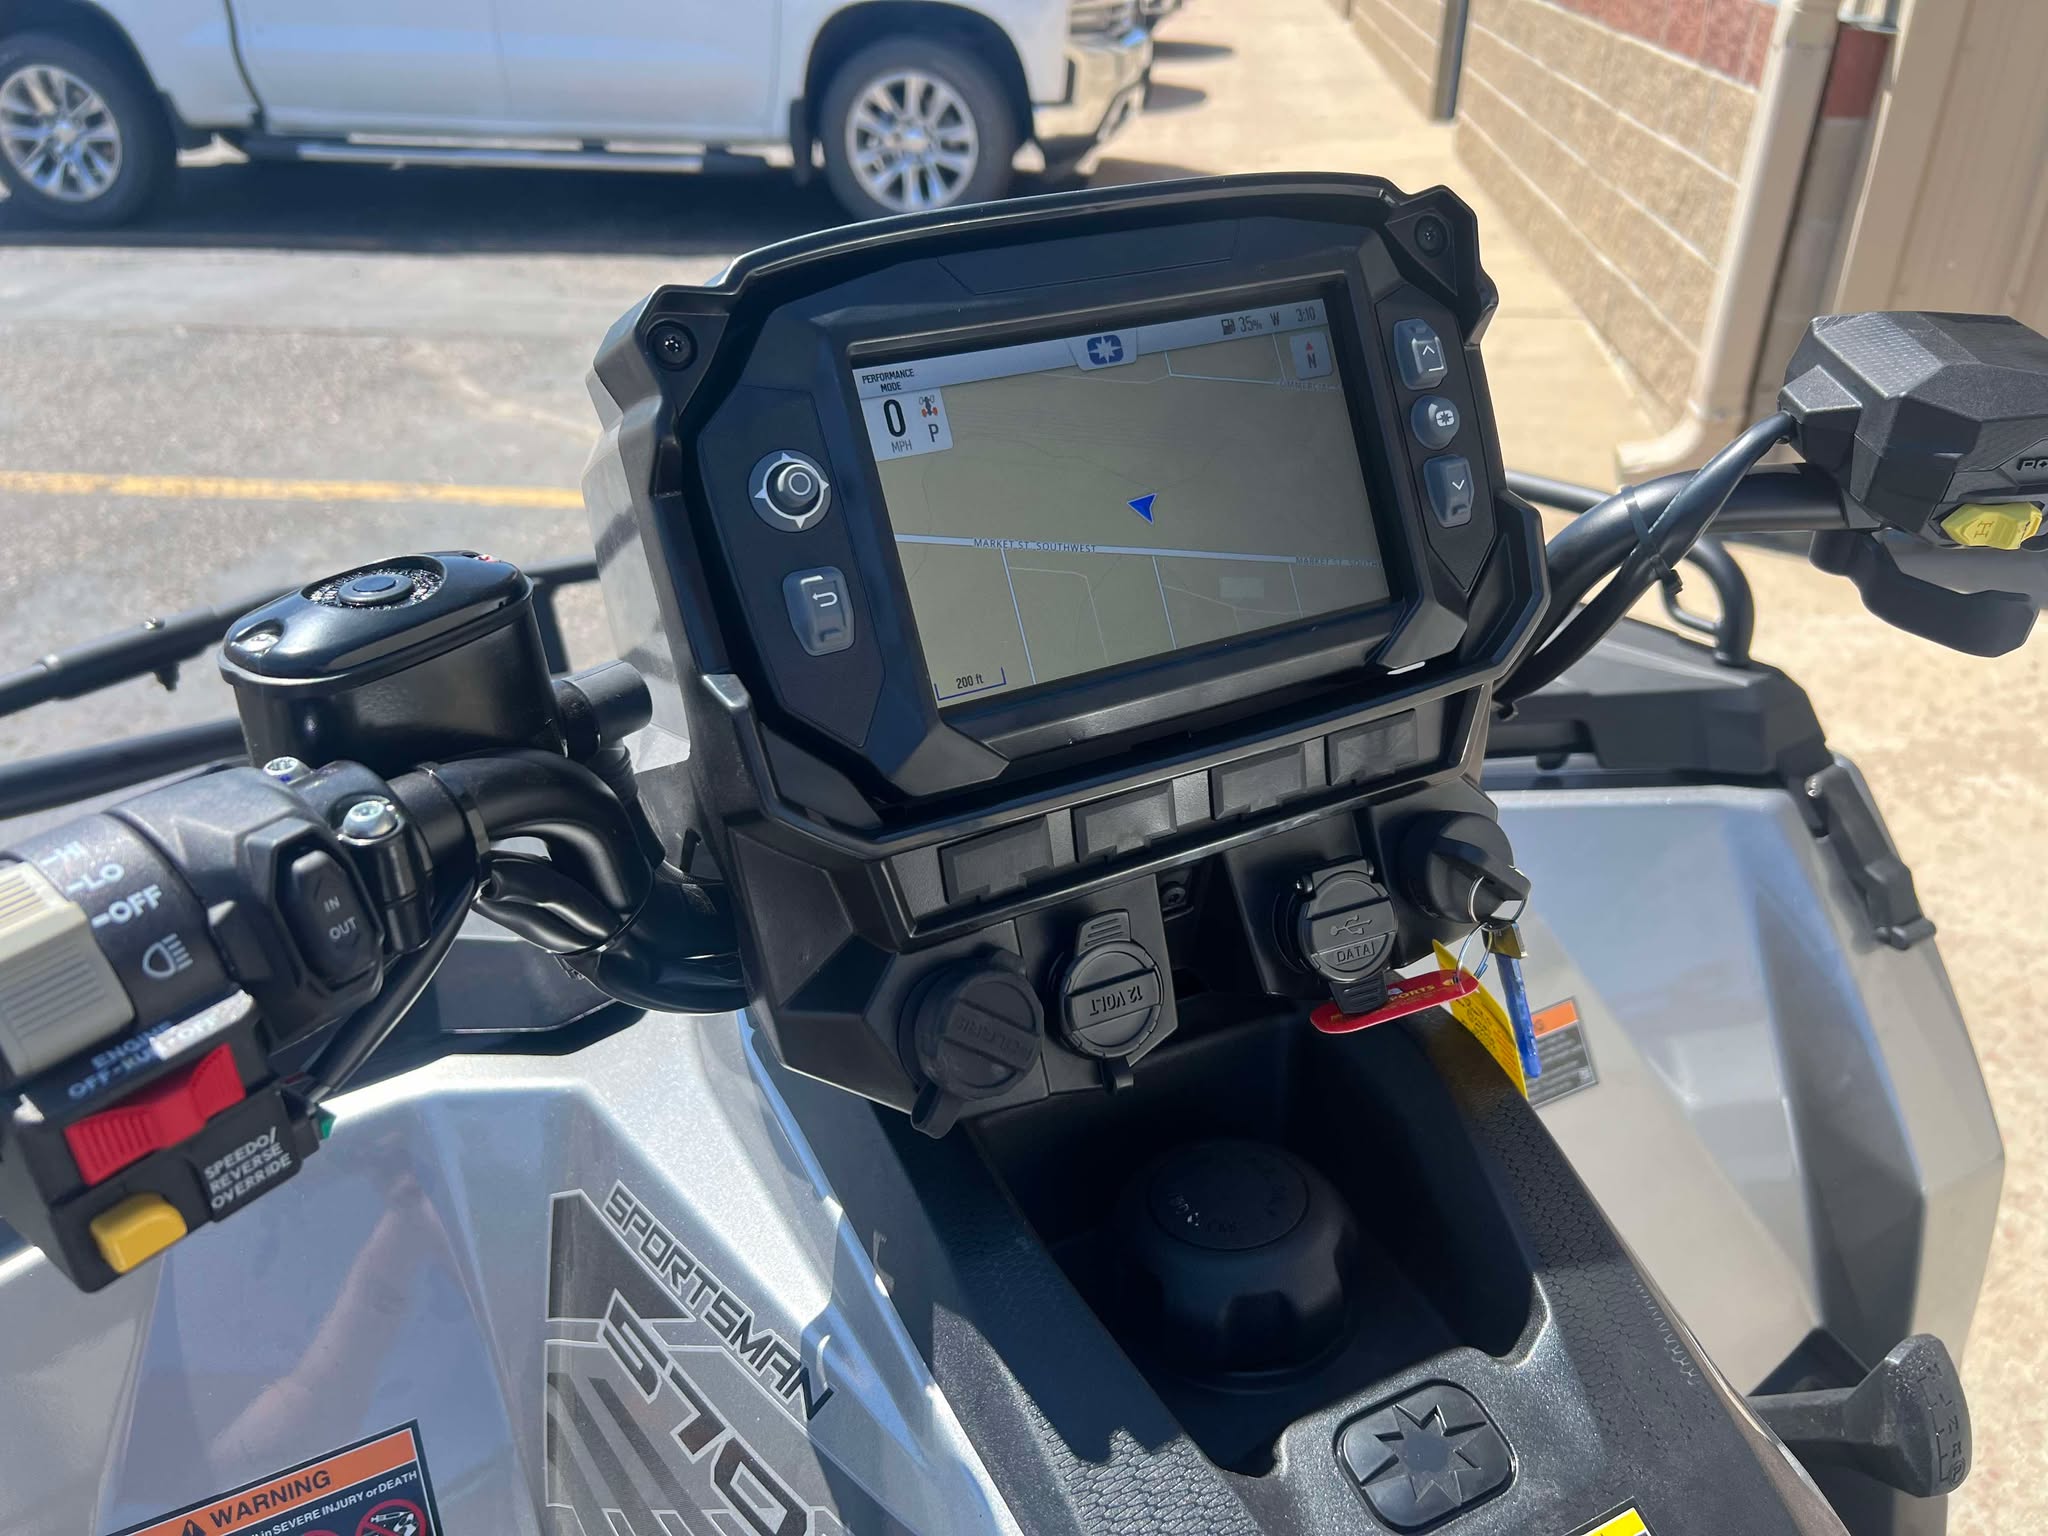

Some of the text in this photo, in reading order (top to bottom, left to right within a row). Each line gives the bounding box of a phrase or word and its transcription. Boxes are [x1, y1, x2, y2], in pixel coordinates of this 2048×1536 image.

[1239, 306, 1316, 333] 35% W 3:10
[1307, 352, 1317, 369] N
[861, 368, 915, 385] PERFORMANCE
[880, 381, 902, 393] MODE
[883, 399, 906, 437] 0
[928, 423, 939, 442] P
[891, 439, 913, 454] MPH
[973, 538, 1096, 553] MARKET ST SOUTHWEST
[955, 672, 984, 690] 200 ft
[323, 896, 341, 913] IN
[329, 917, 358, 941] OUT
[1336, 942, 1371, 964] DATA
[1090, 985, 1143, 1016] 12 VOLT
[204, 1126, 277, 1180] SPEEDO/
[208, 1142, 284, 1194] REVERSE
[211, 1154, 293, 1209] OVERRIDE
[602, 1181, 835, 1421] SPORTSMAN
[600, 1288, 808, 1536] 570
[209, 1470, 332, 1529] WARNING
[272, 1510, 321, 1535] SEVERE
[321, 1490, 364, 1517] INJURY
[365, 1486, 378, 1499] or
[378, 1470, 418, 1496] DEATH
